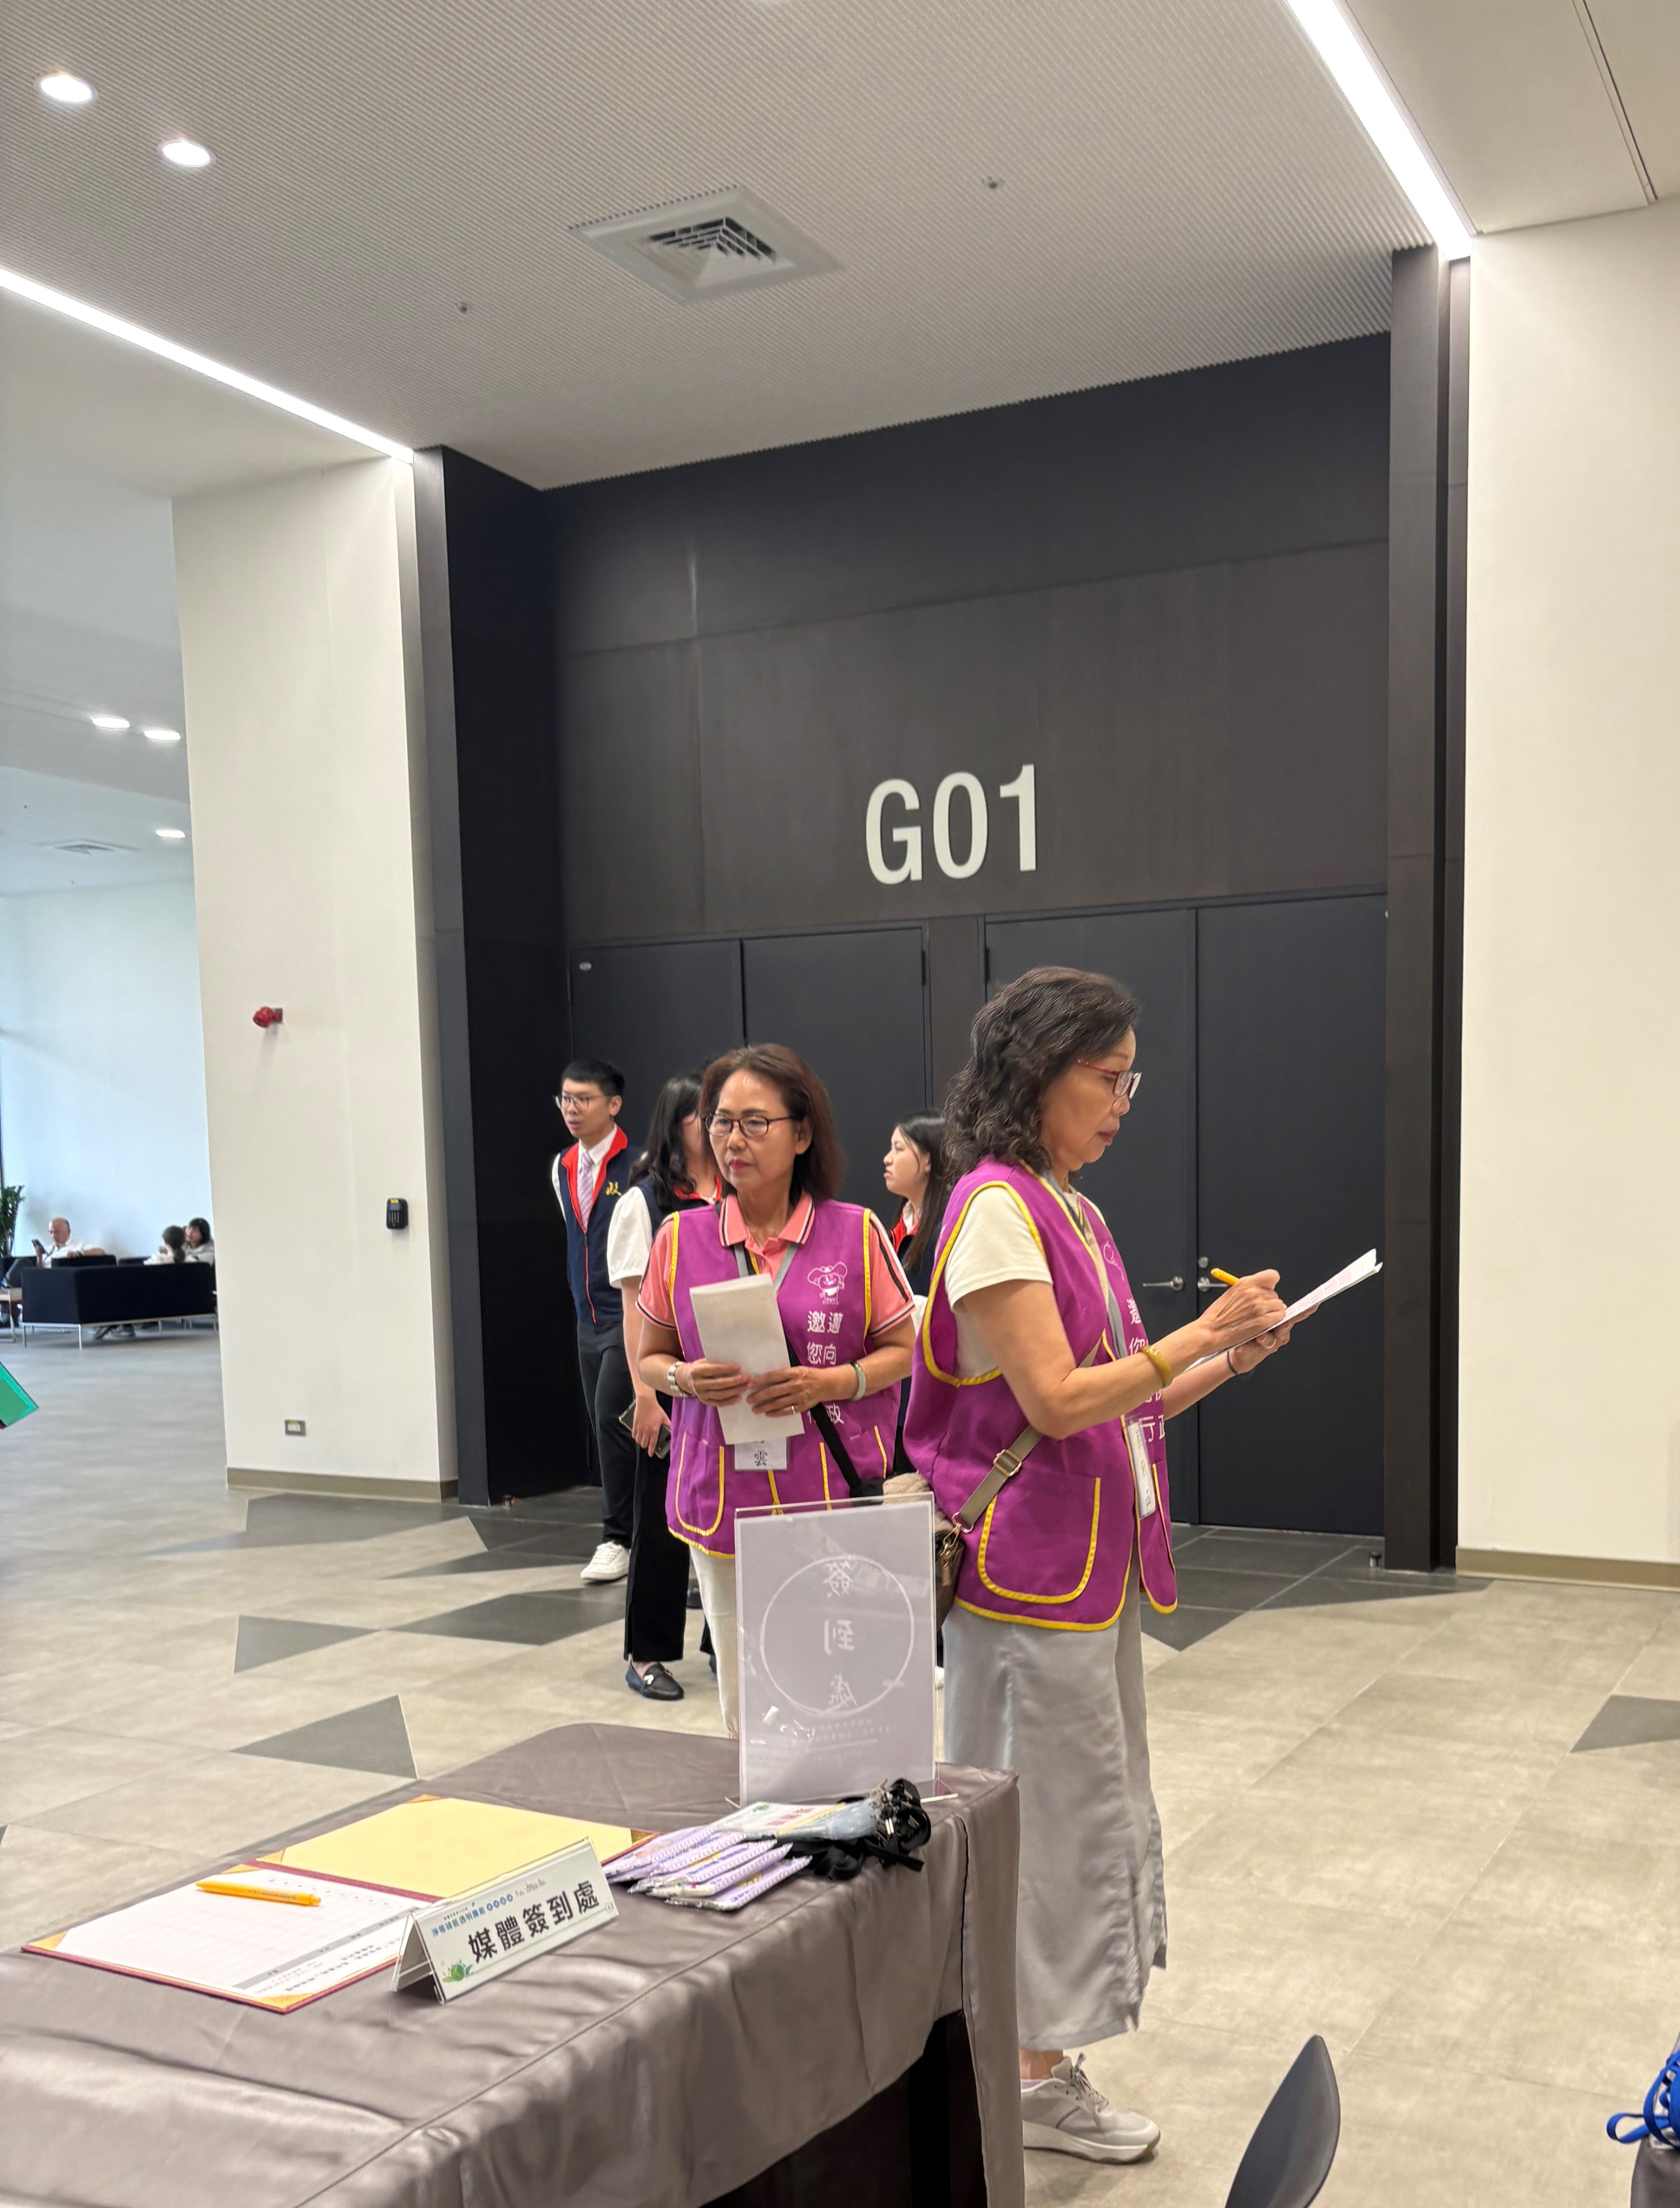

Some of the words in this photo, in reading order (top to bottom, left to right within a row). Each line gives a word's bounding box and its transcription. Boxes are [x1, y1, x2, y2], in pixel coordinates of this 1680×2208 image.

[866, 764, 1036, 885] G01
[468, 1880, 599, 1964] 媒體簽到處
